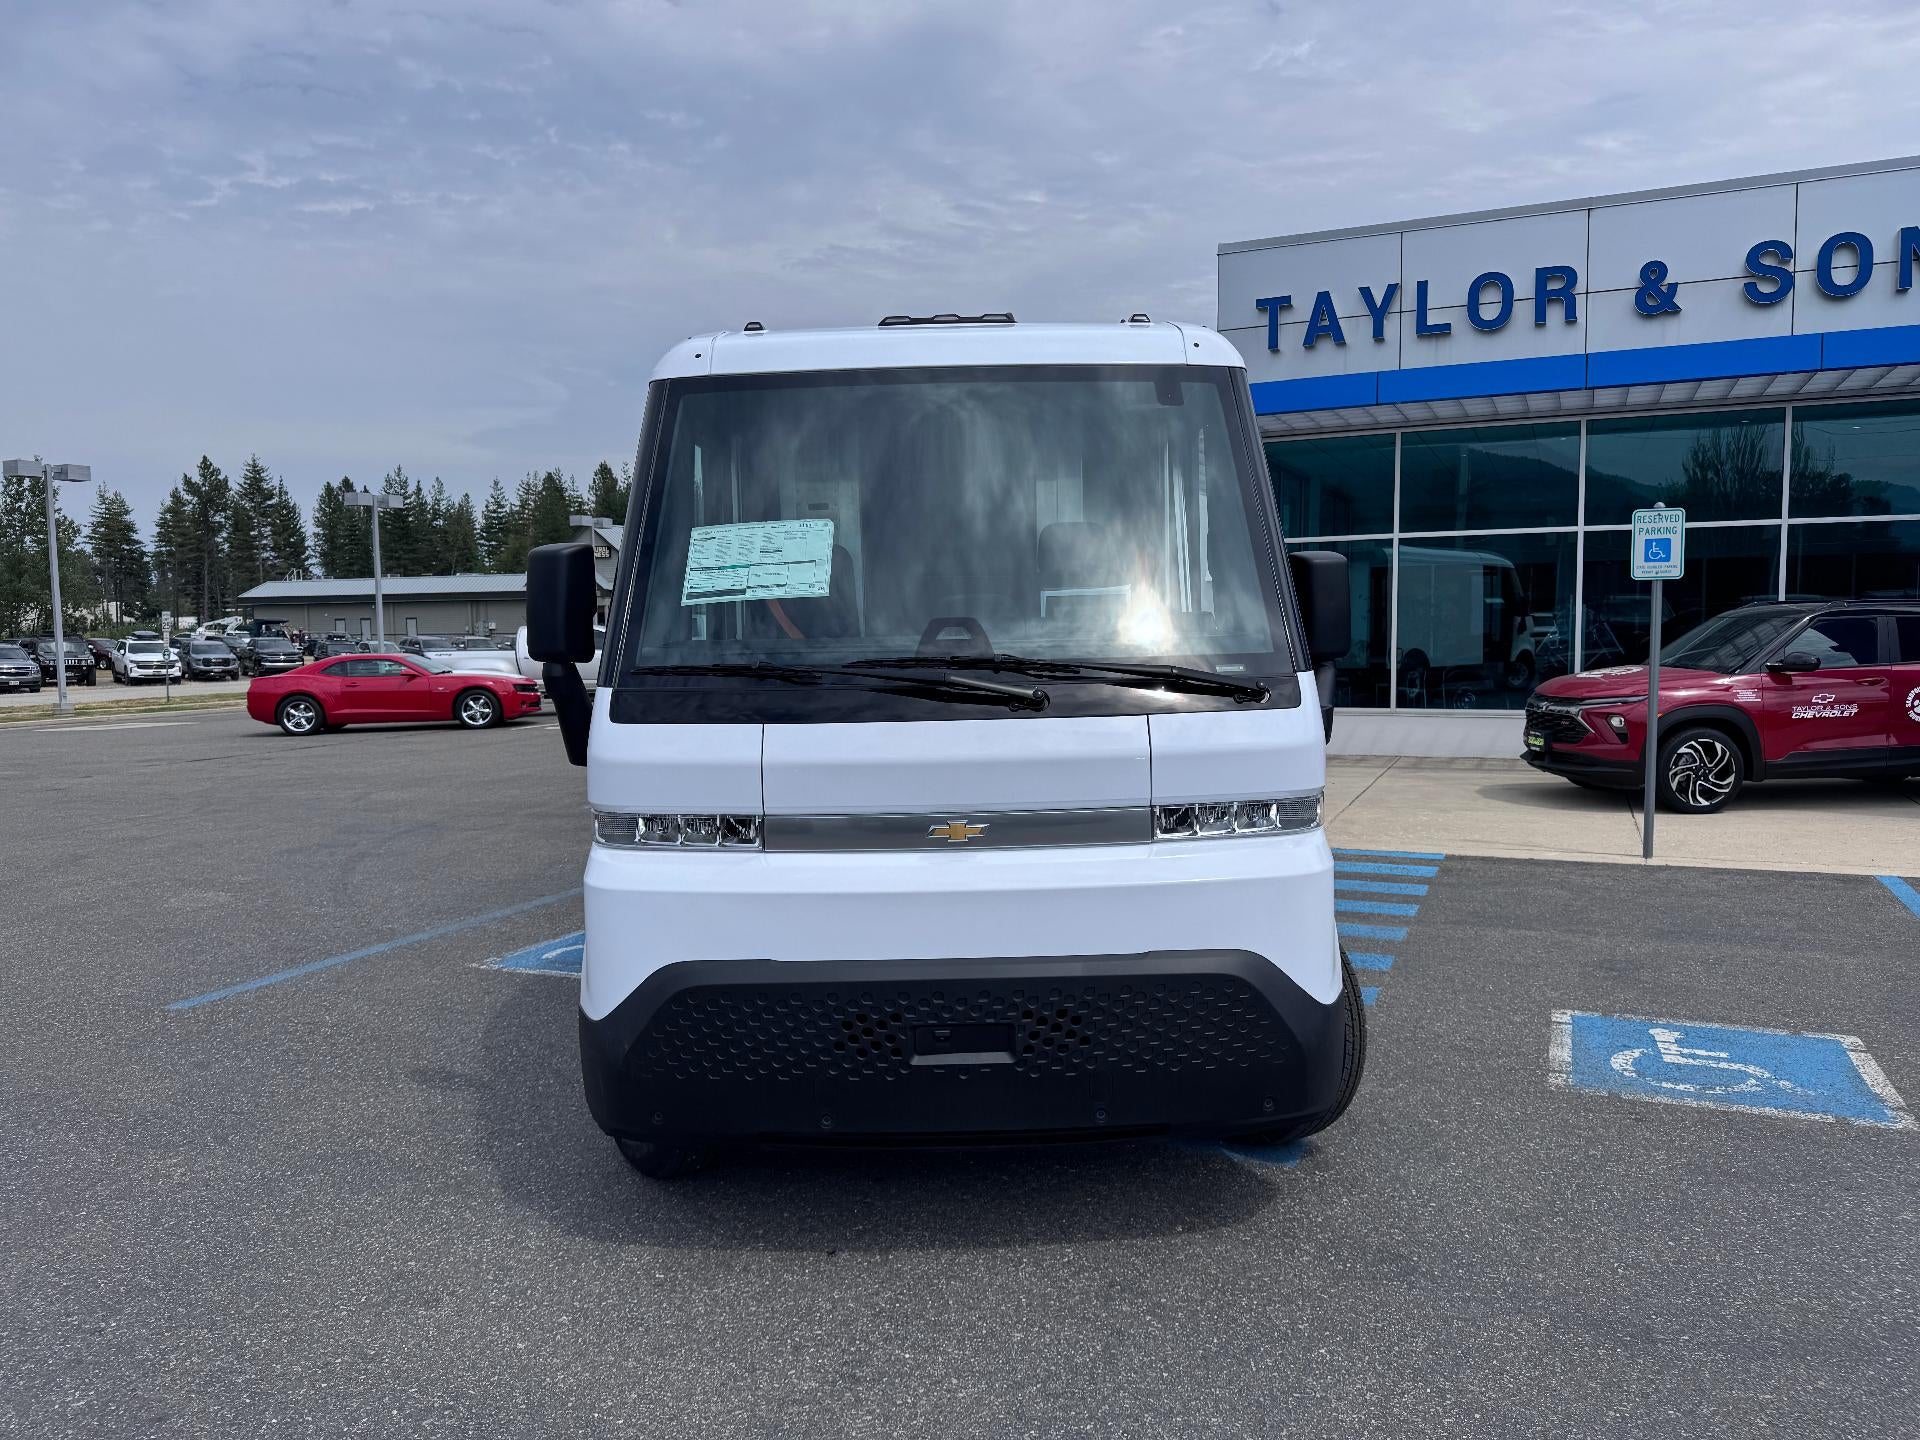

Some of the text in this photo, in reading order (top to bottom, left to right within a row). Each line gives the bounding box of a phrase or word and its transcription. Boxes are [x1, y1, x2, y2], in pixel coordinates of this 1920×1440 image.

[1254, 264, 1579, 352] TAYLOR
[1633, 259, 1683, 317] &
[1636, 514, 1680, 523] RESERVED
[1638, 526, 1678, 535] PARKING
[1791, 709, 1859, 719] CHEVROLET
